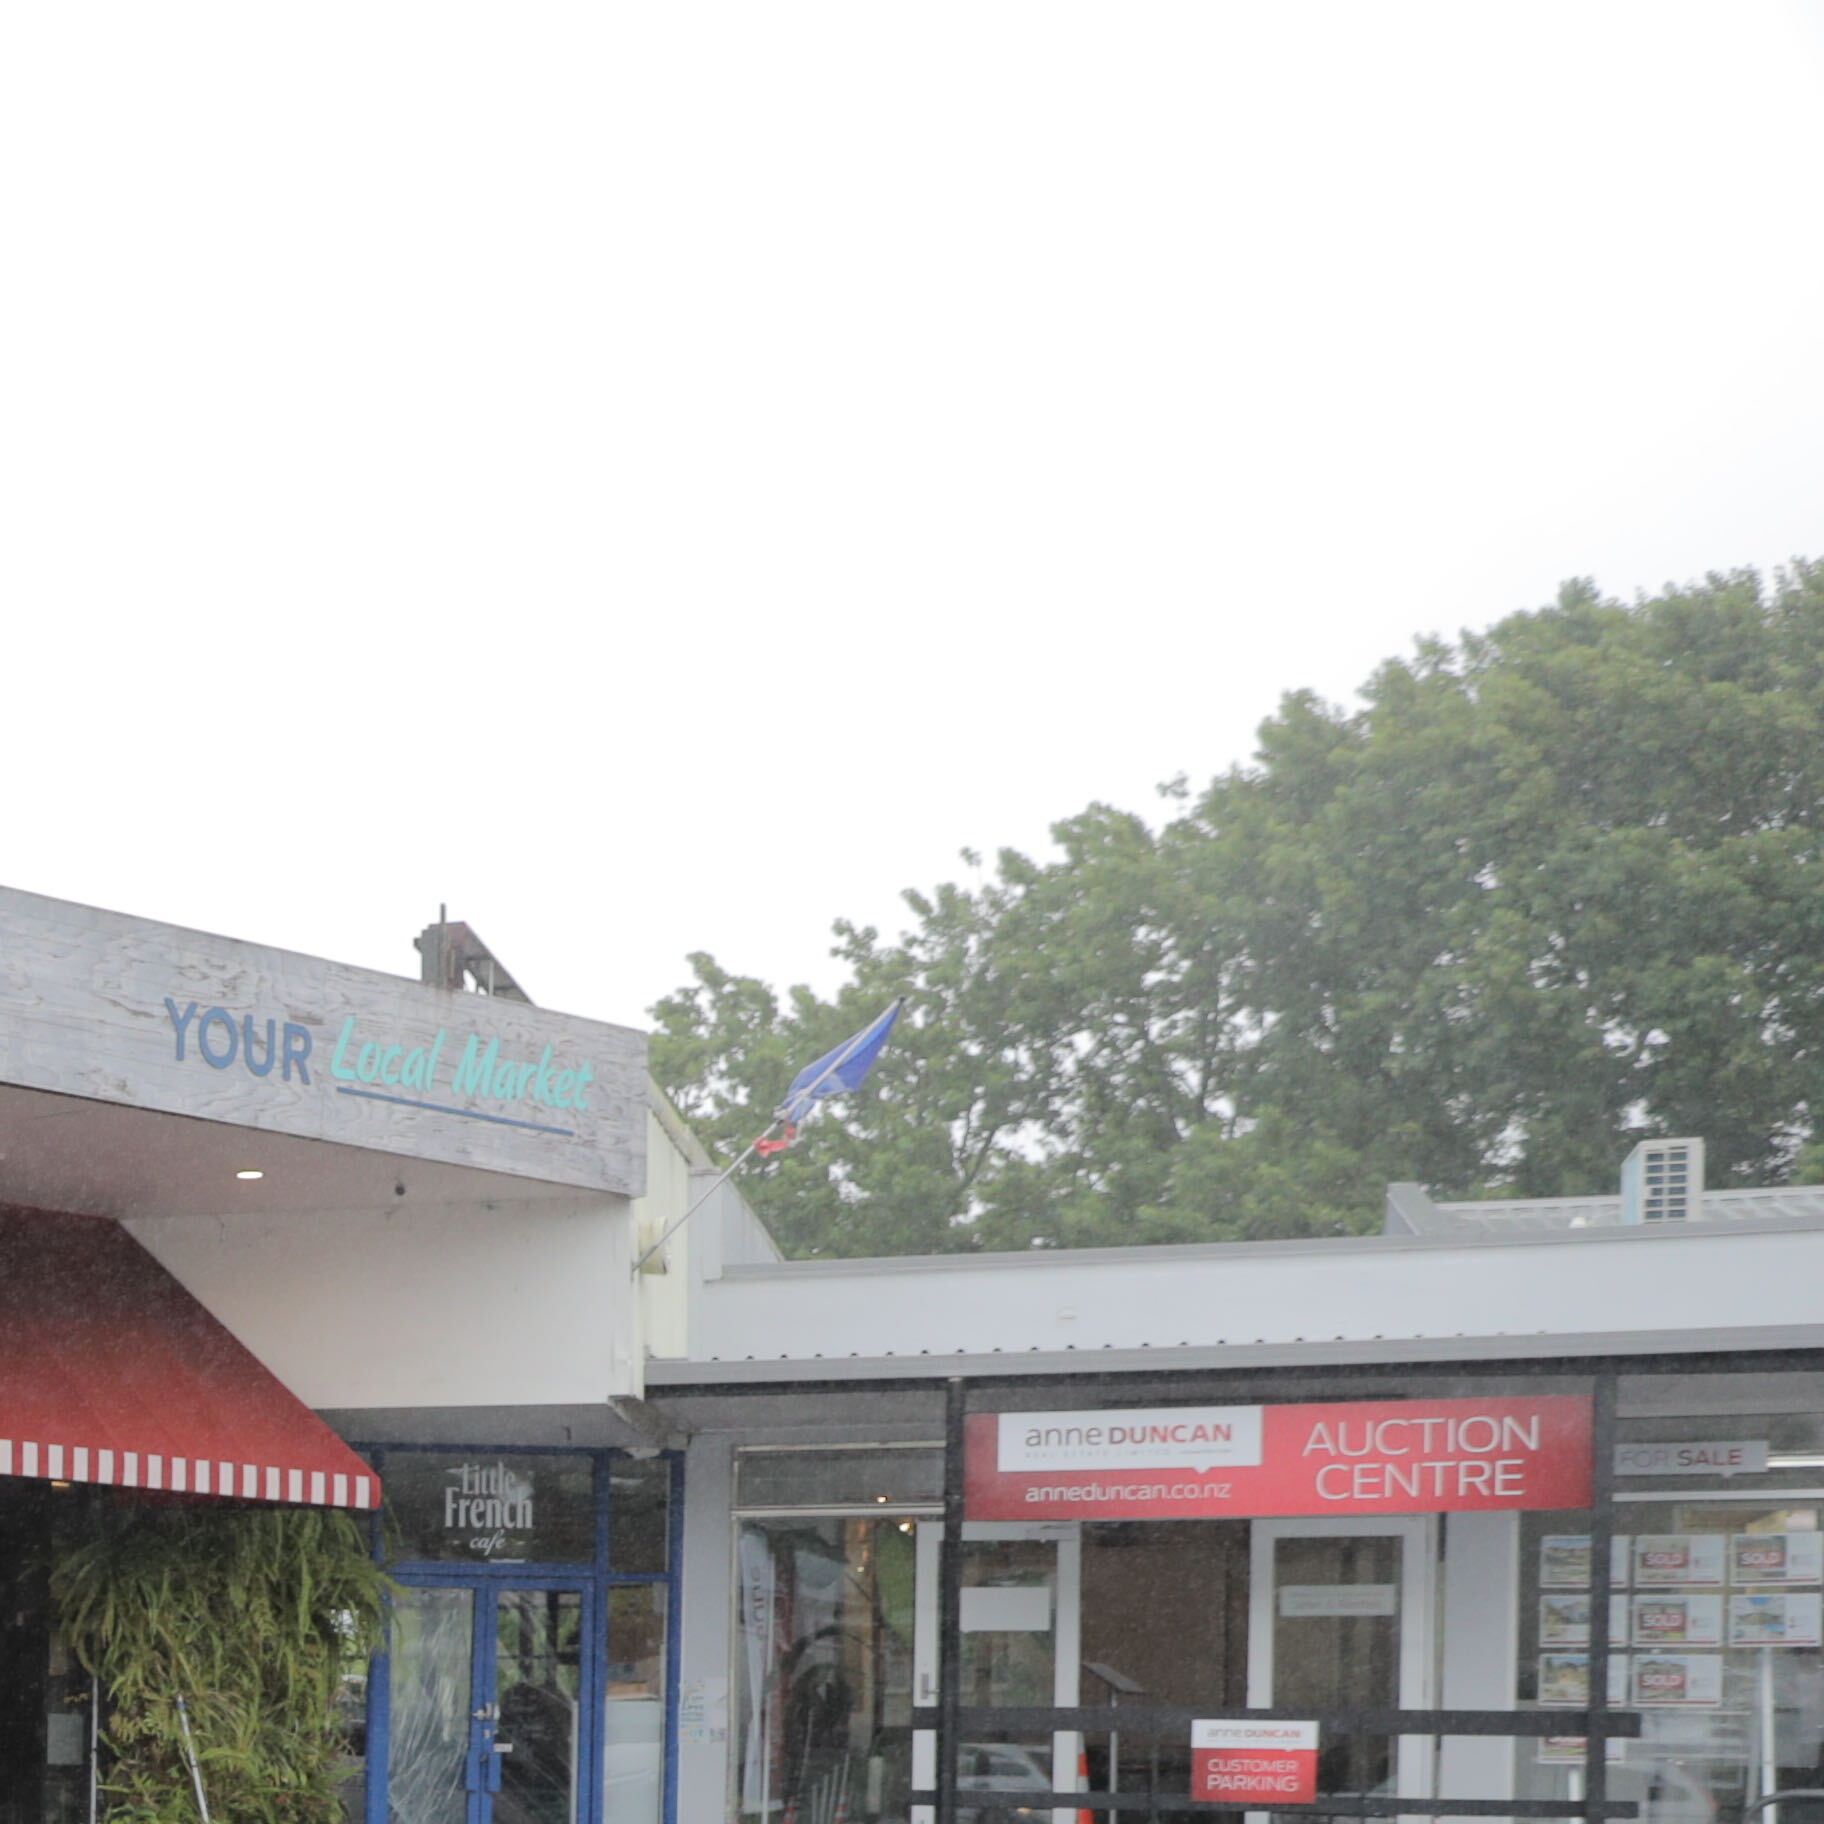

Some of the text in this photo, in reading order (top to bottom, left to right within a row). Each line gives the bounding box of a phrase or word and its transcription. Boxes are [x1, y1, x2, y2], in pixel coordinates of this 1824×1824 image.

[164, 997, 596, 1111] YOUR Local Market
[1024, 1423, 1233, 1447] anne DUNCAN
[1301, 1414, 1541, 1458] AUCTION
[1620, 1448, 1744, 1468] FOR SALE
[462, 1461, 516, 1495] Little
[1315, 1458, 1526, 1501] CENTRE
[1024, 1481, 1233, 1502] anneduncan.co.nz
[444, 1486, 533, 1529] French
[1644, 1553, 1683, 1566] SOLD
[1740, 1551, 1780, 1565] SOLD
[1642, 1613, 1682, 1628] SOLD
[1641, 1672, 1681, 1687] SOLD
[1244, 1729, 1301, 1739] DUNCAN
[1207, 1758, 1300, 1774] CUSTOMER
[1207, 1773, 1301, 1793] PARKING
